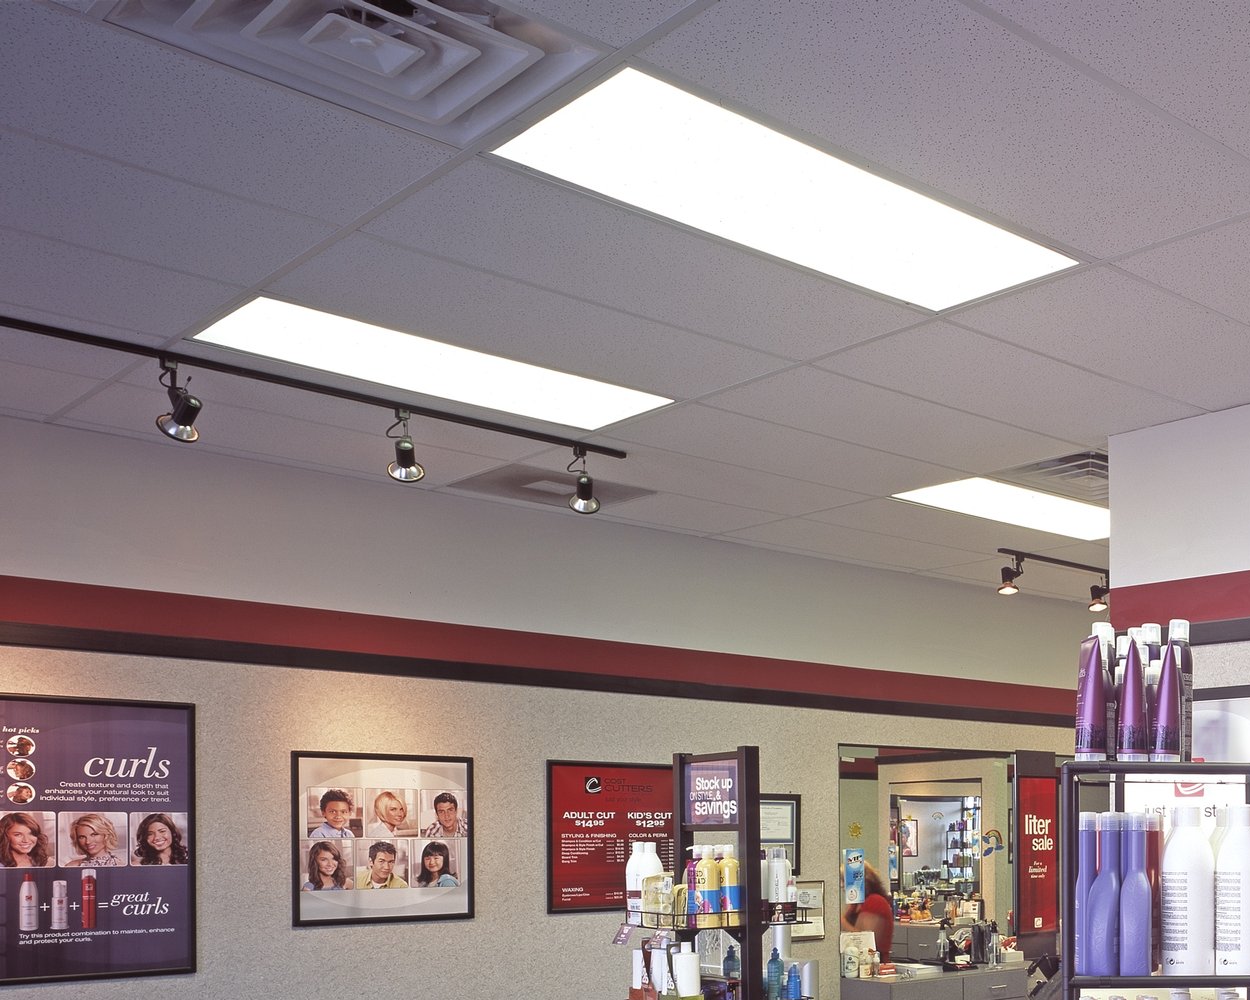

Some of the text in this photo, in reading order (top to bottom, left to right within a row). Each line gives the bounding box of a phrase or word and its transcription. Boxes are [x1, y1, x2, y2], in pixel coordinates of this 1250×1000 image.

[84, 747, 170, 778] curls
[604, 784, 653, 792] CUTTERS
[696, 776, 732, 792] Stock up
[716, 790, 721, 800] &
[695, 798, 737, 818] savings
[1025, 814, 1051, 835] liter
[1032, 835, 1053, 851] sale
[1028, 865, 1047, 873] limited
[110, 892, 149, 906] great
[123, 897, 169, 915] curls
